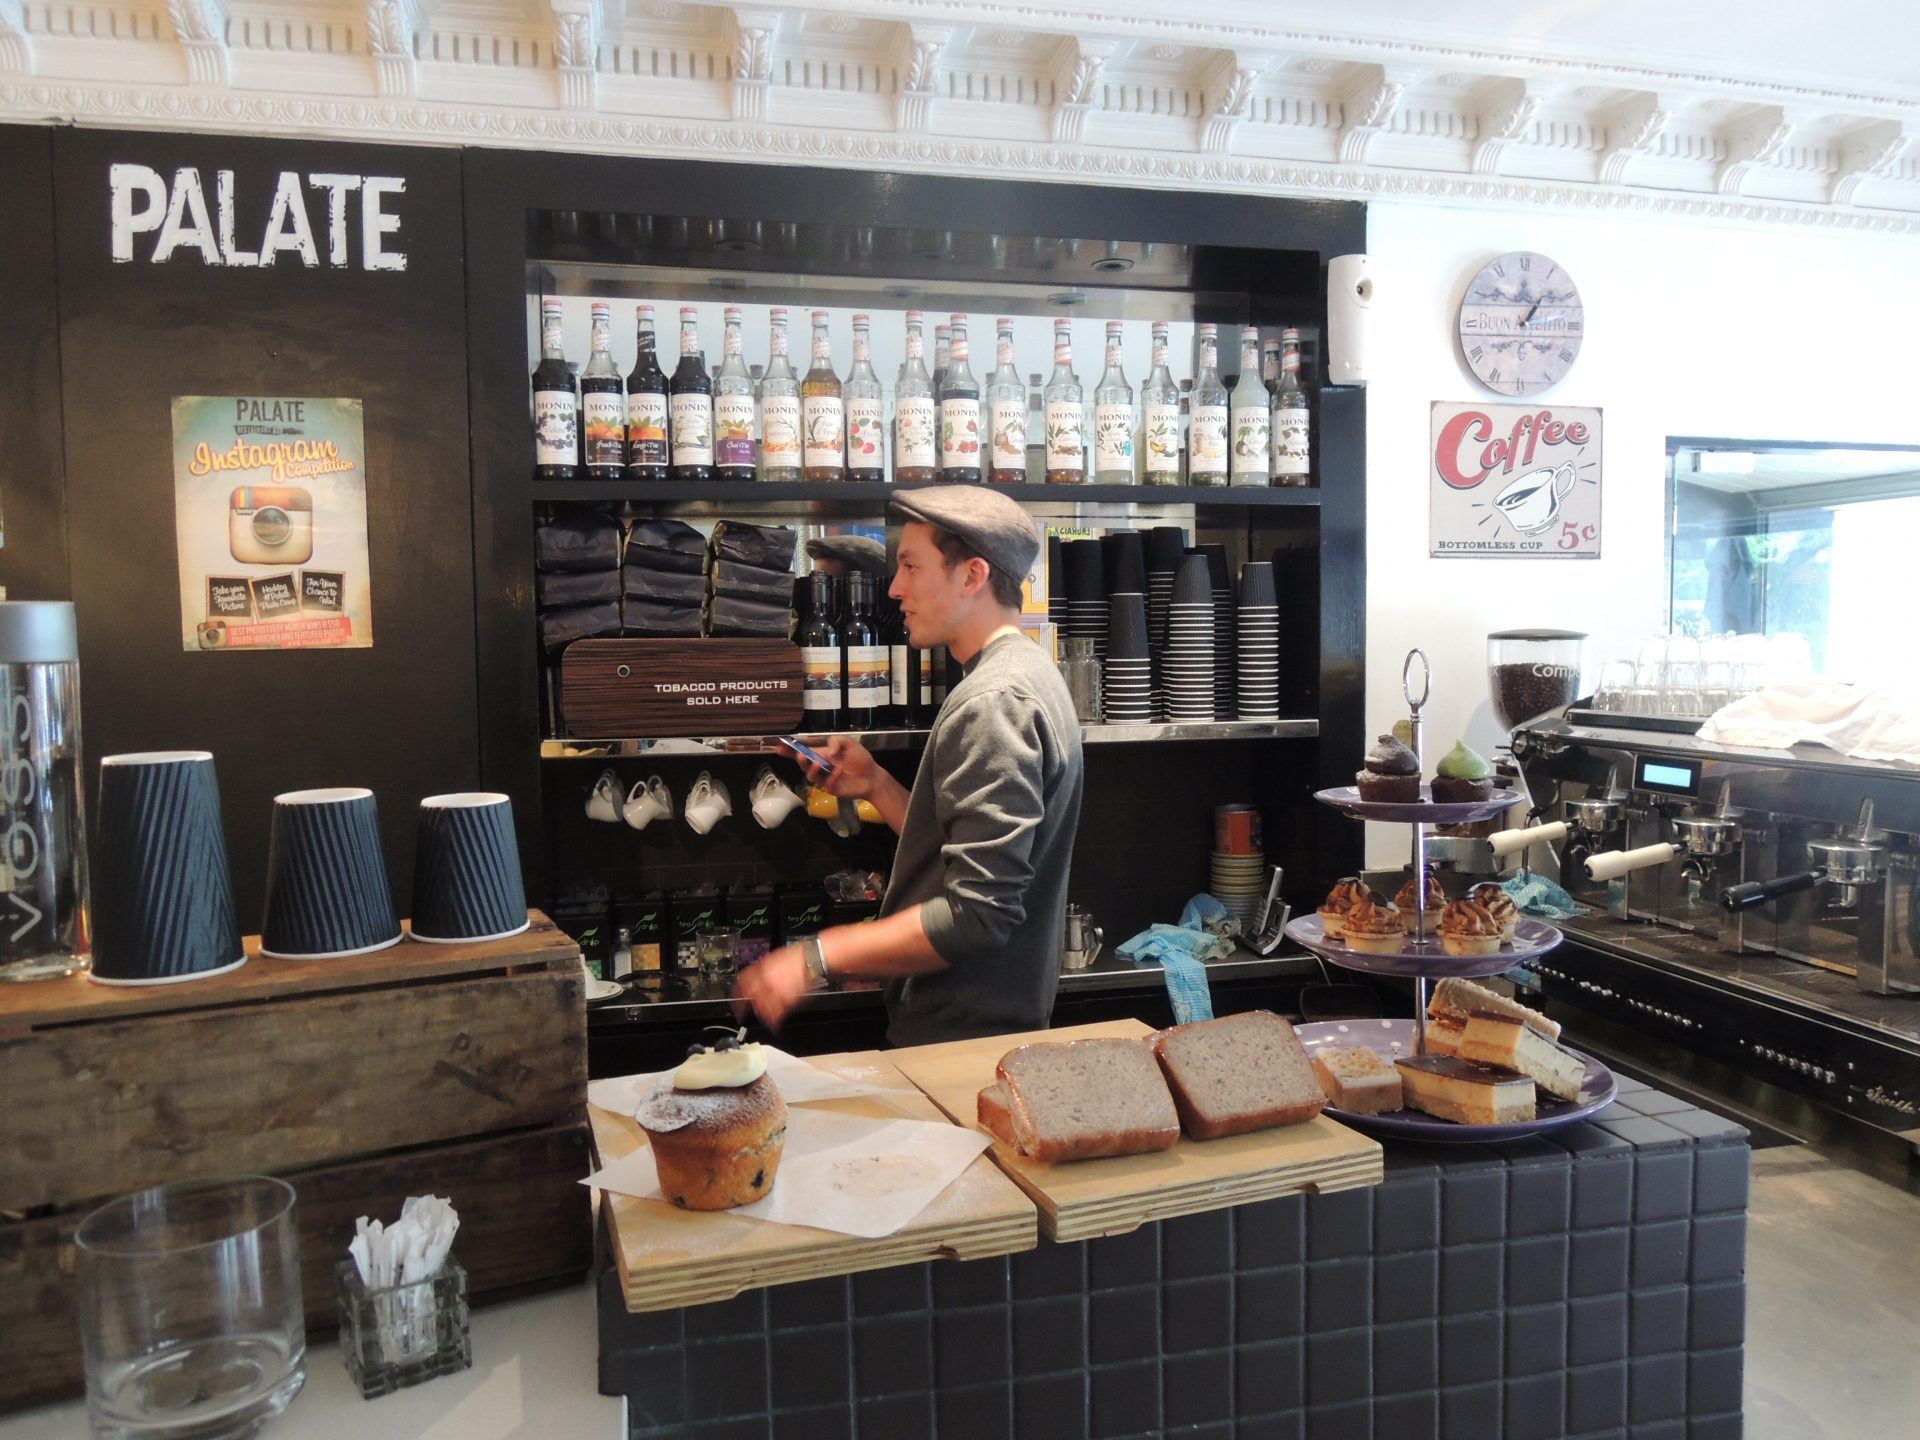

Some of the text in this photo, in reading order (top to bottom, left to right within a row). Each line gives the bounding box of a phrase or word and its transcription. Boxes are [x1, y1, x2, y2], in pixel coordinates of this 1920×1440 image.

[110, 163, 408, 272] PALATE
[236, 399, 305, 423] PALATE
[537, 402, 574, 411] MONIN
[673, 403, 708, 412] MONIN
[719, 405, 753, 413] MONIN
[764, 406, 798, 414] MONIN
[900, 408, 932, 416] MONIN
[1099, 413, 1131, 421] MONIN
[1435, 410, 1590, 490] Coffee
[189, 438, 339, 482] Instagram
[286, 459, 355, 479] Competition
[1438, 541, 1543, 550] BOTTOMLESS CUP
[654, 681, 788, 692] TOBACCO PRODUCTS
[687, 695, 759, 706] SOLD HERE
